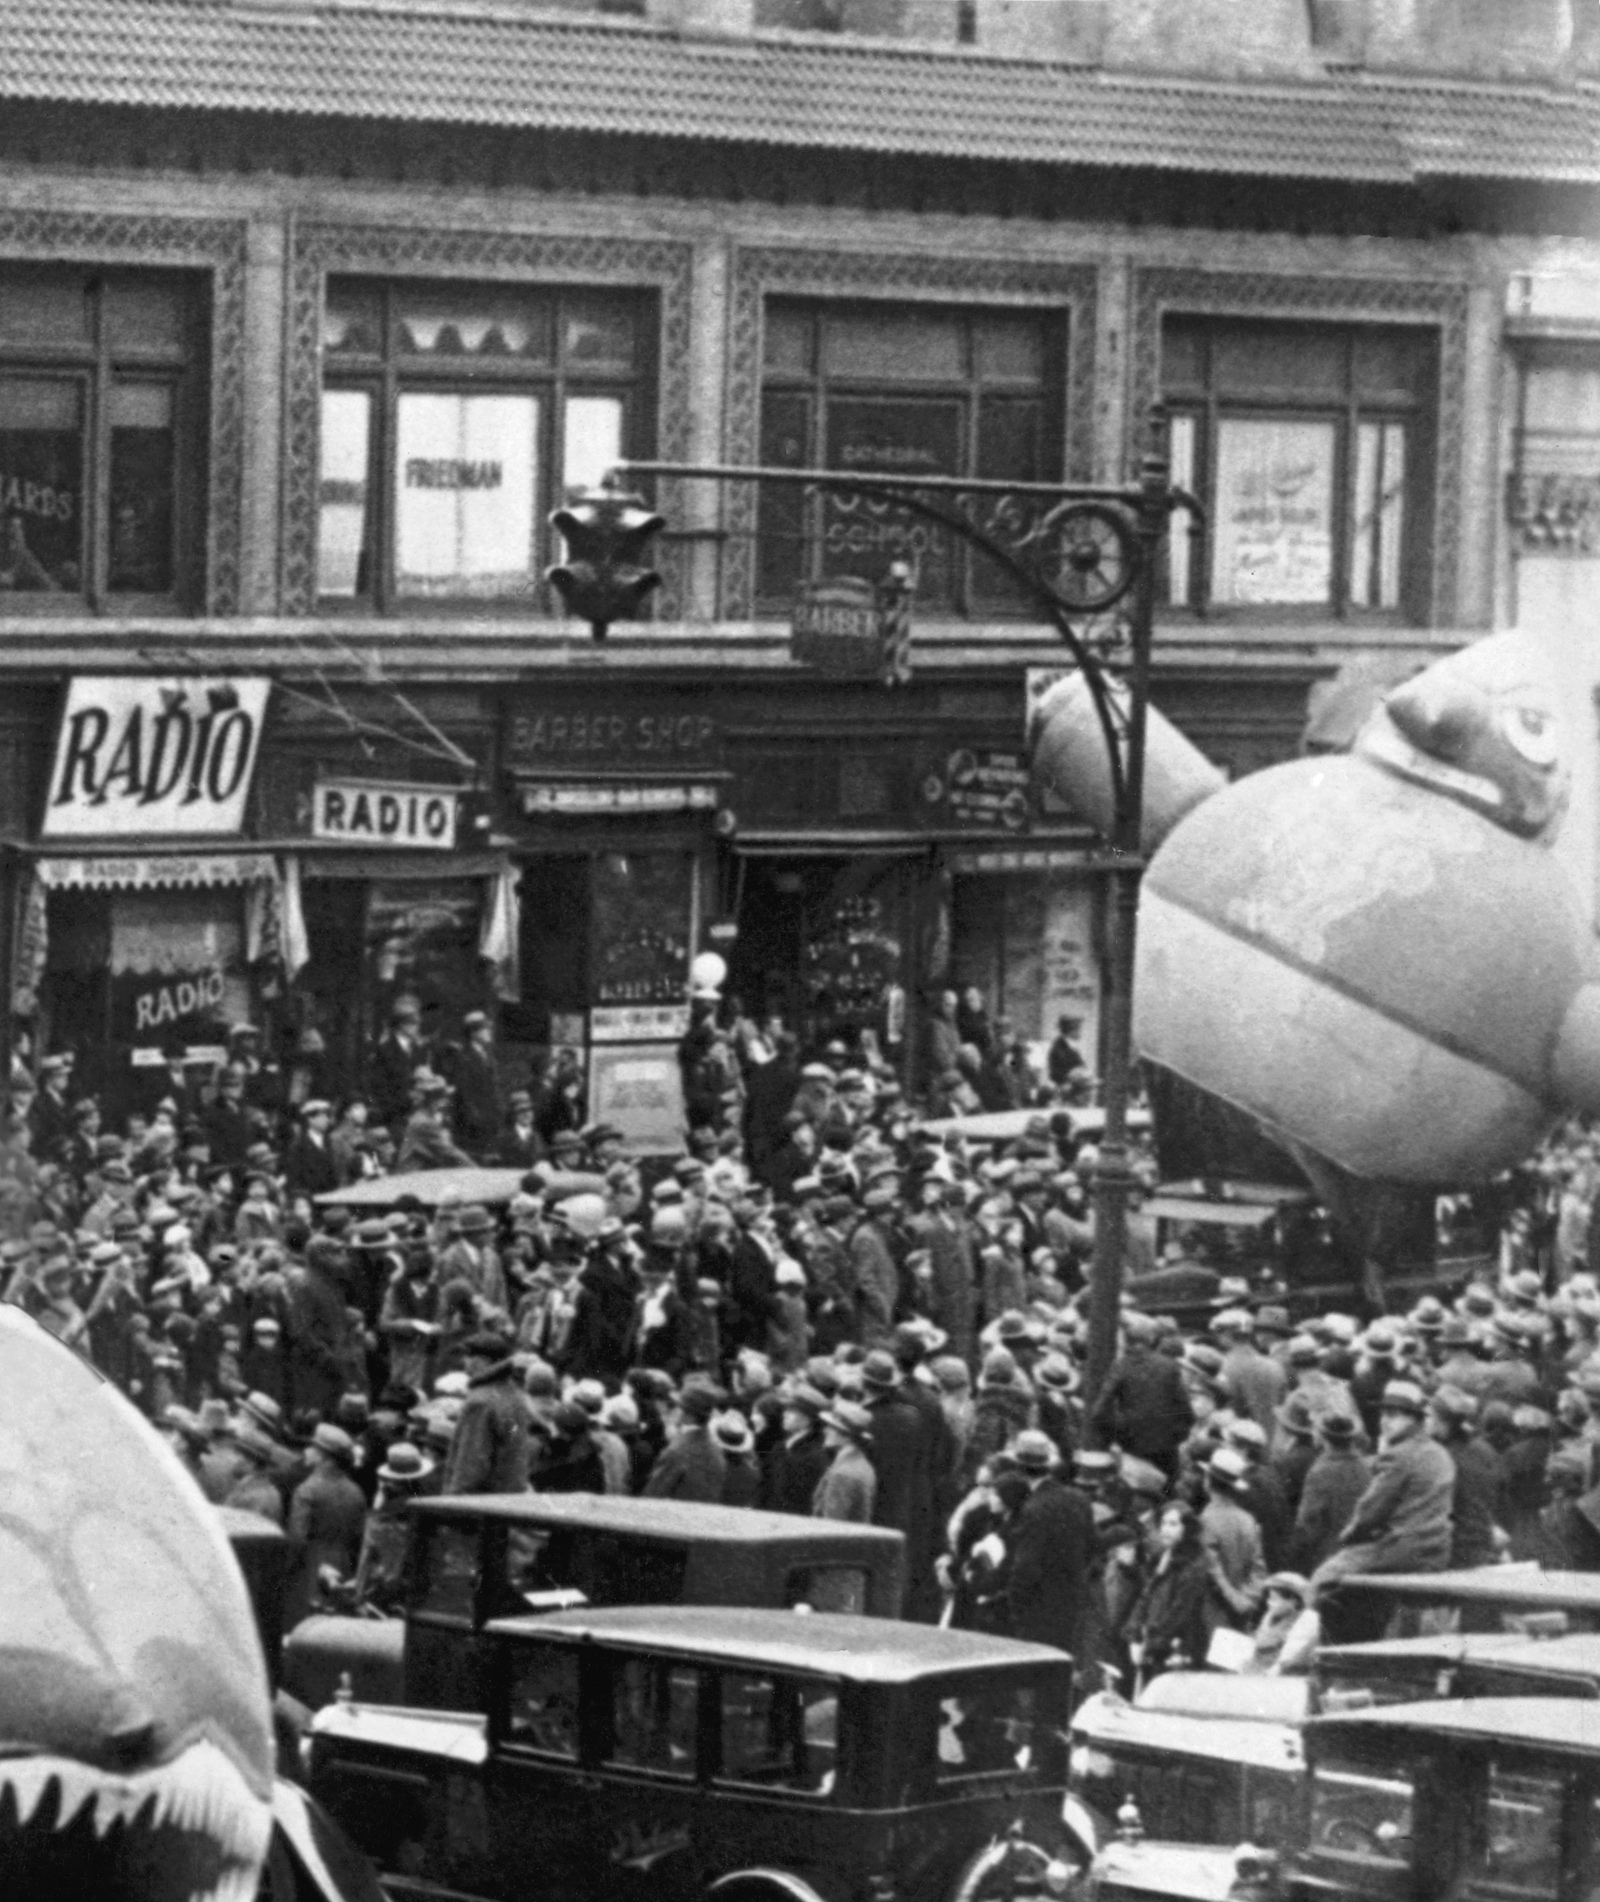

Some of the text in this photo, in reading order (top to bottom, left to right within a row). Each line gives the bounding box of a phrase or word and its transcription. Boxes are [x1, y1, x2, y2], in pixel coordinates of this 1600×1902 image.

[53, 703, 254, 808] RADIO
[513, 715, 714, 750] BARBER SHOP
[323, 791, 448, 837] RADIO
[136, 971, 224, 1029] RADIO
